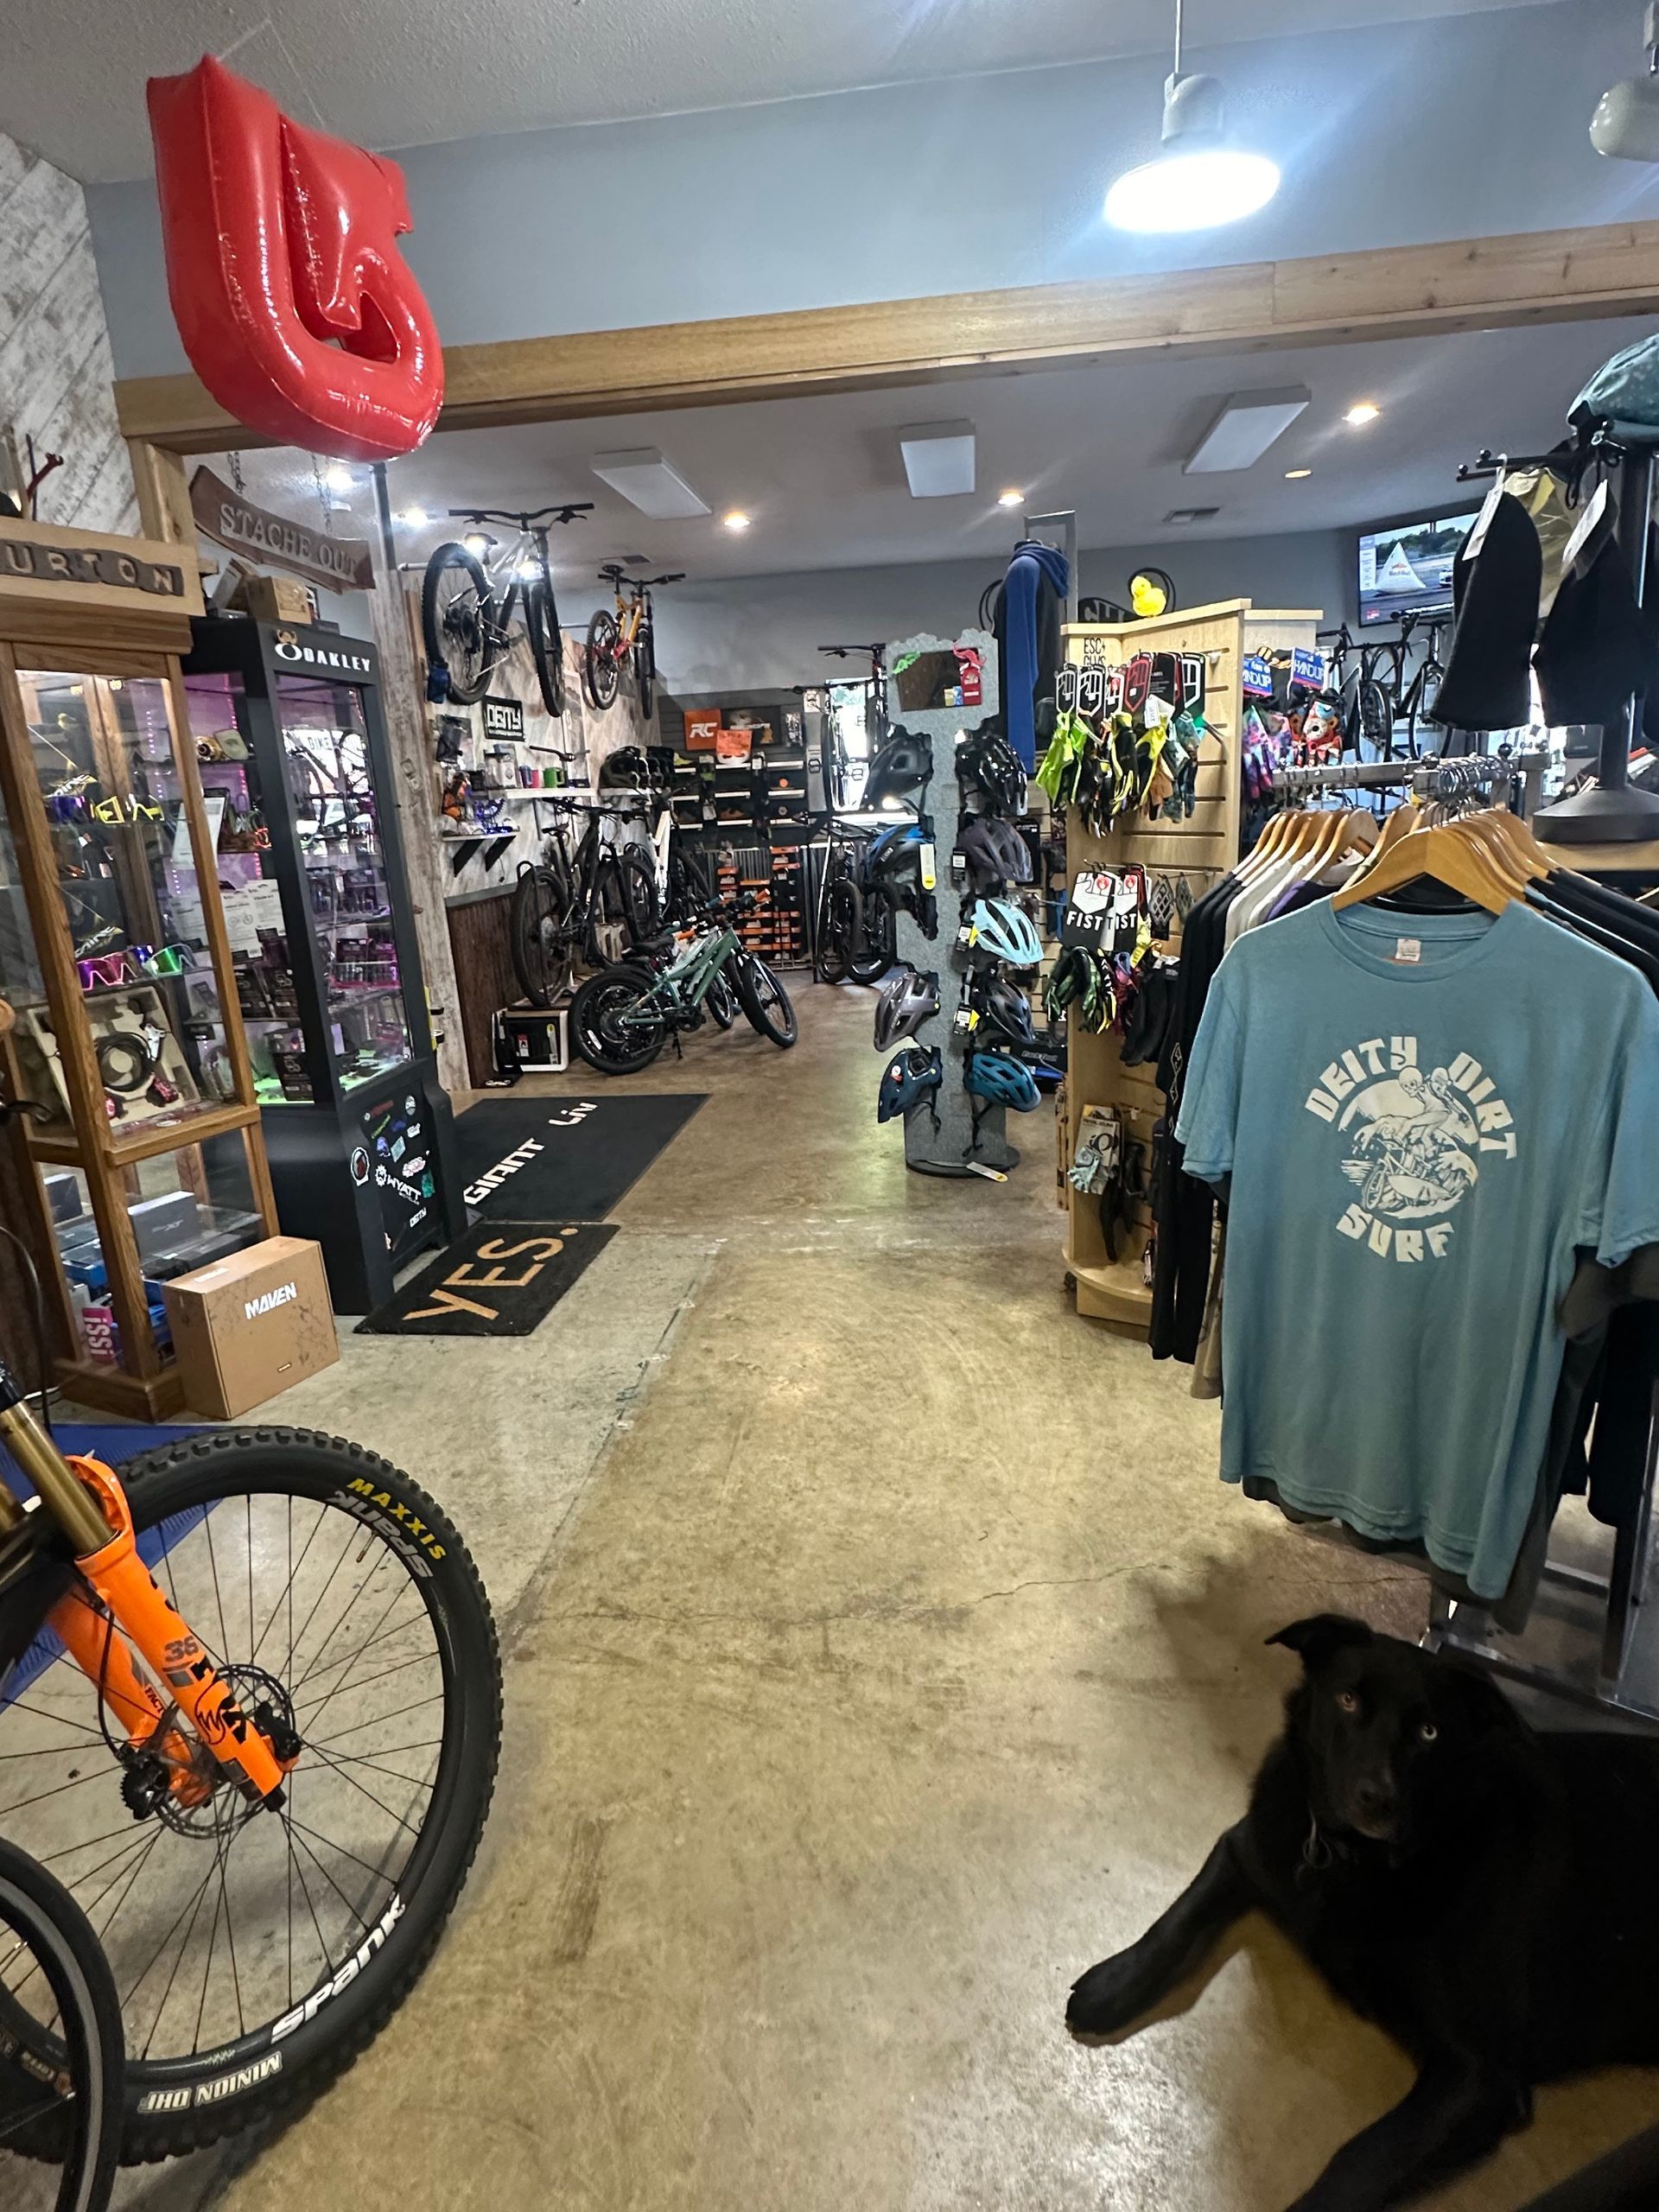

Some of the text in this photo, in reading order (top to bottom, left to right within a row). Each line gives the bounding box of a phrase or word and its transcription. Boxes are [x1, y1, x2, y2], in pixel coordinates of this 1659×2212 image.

[220, 503, 356, 576] STACHE OUT
[4, 544, 174, 593] URTON
[303, 648, 371, 672] OAKLEY
[1243, 670, 1272, 688] ANDUP
[690, 721, 718, 738] RC
[1066, 911, 1103, 931] FIST
[1115, 912, 1137, 930] IST
[1305, 1036, 1517, 1160] DEITY DIRT
[387, 1174, 422, 1200] WYATT
[462, 1137, 545, 1205] GIANT
[1336, 1203, 1454, 1262] SURF
[402, 1227, 579, 1321] YES.
[245, 1281, 297, 1320] MAVEN
[346, 1478, 447, 1560] MAXXIS
[165, 1636, 200, 1662] 36
[145, 1686, 165, 1713] FACT
[137, 2050, 283, 2113] MINION DHF
